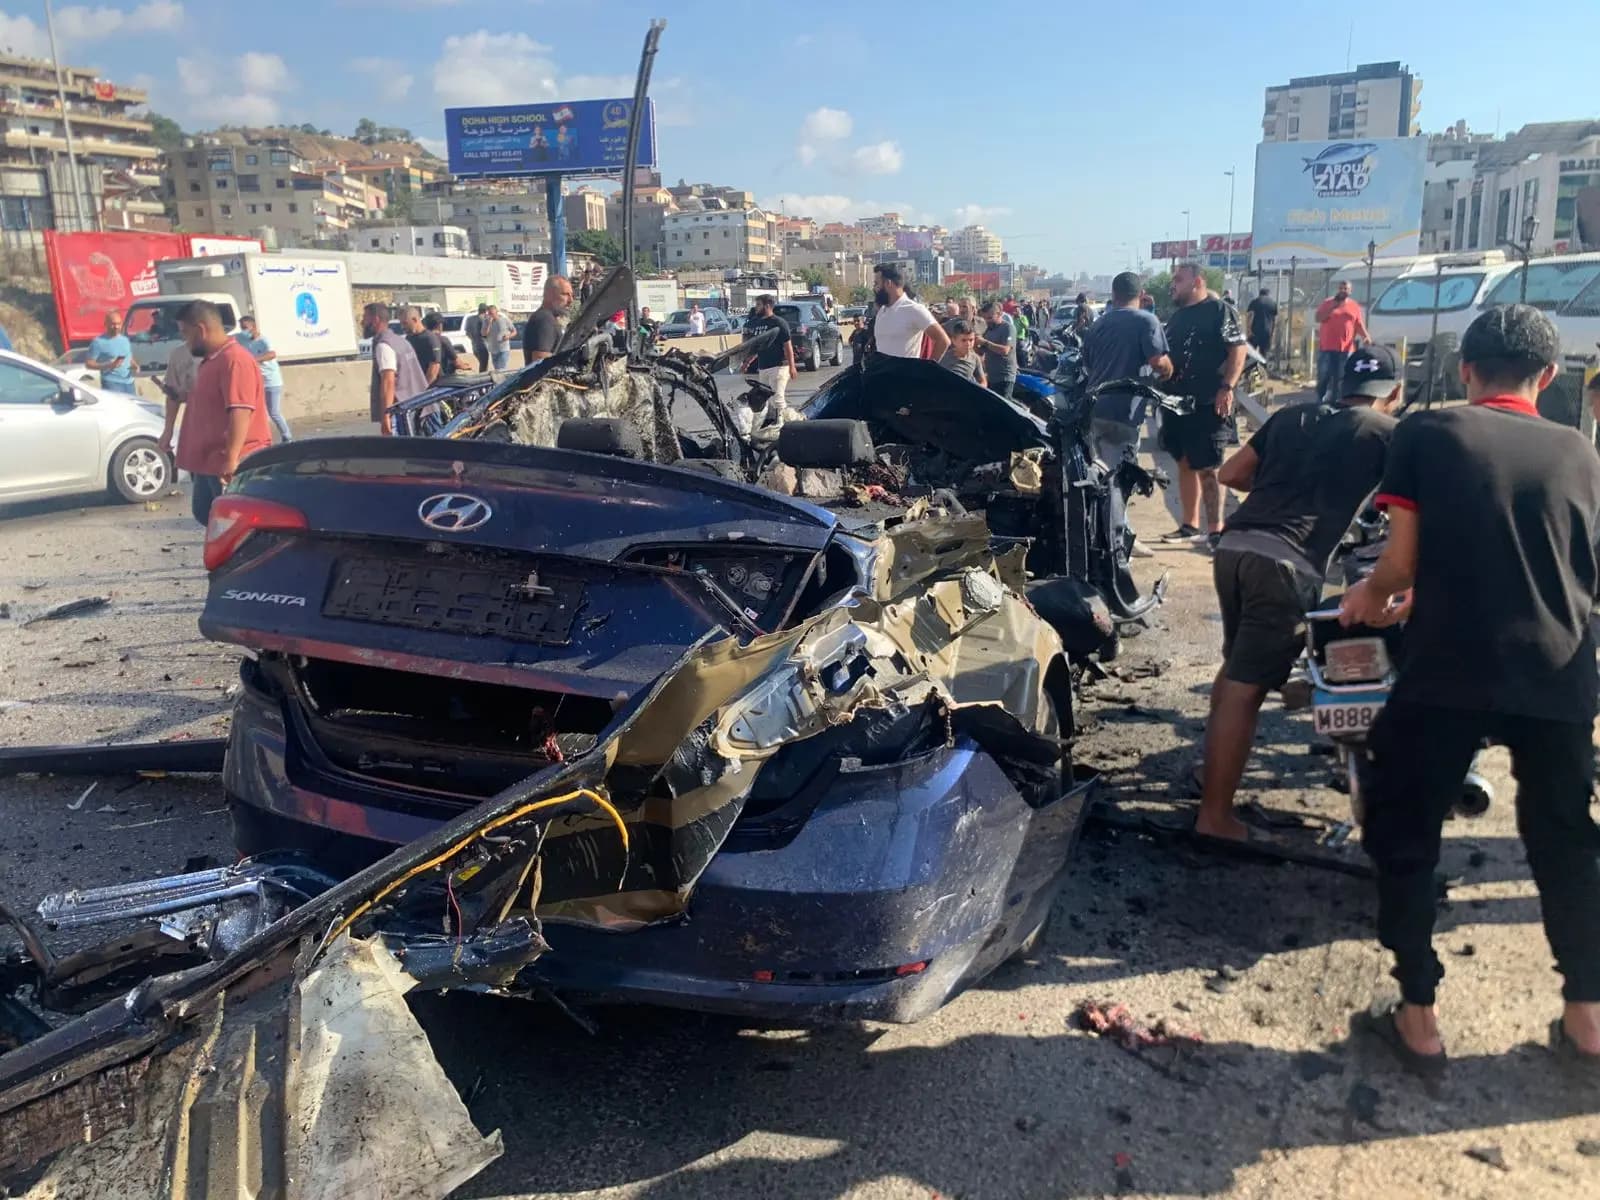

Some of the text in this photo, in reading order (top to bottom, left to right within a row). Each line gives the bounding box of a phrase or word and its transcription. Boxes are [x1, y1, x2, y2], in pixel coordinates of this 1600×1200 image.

[462, 113, 546, 126] DOHA HIGH SCHOOL
[1324, 163, 1361, 175] ABOU
[1315, 173, 1369, 190] ZIAD
[221, 589, 306, 607] SONATA
